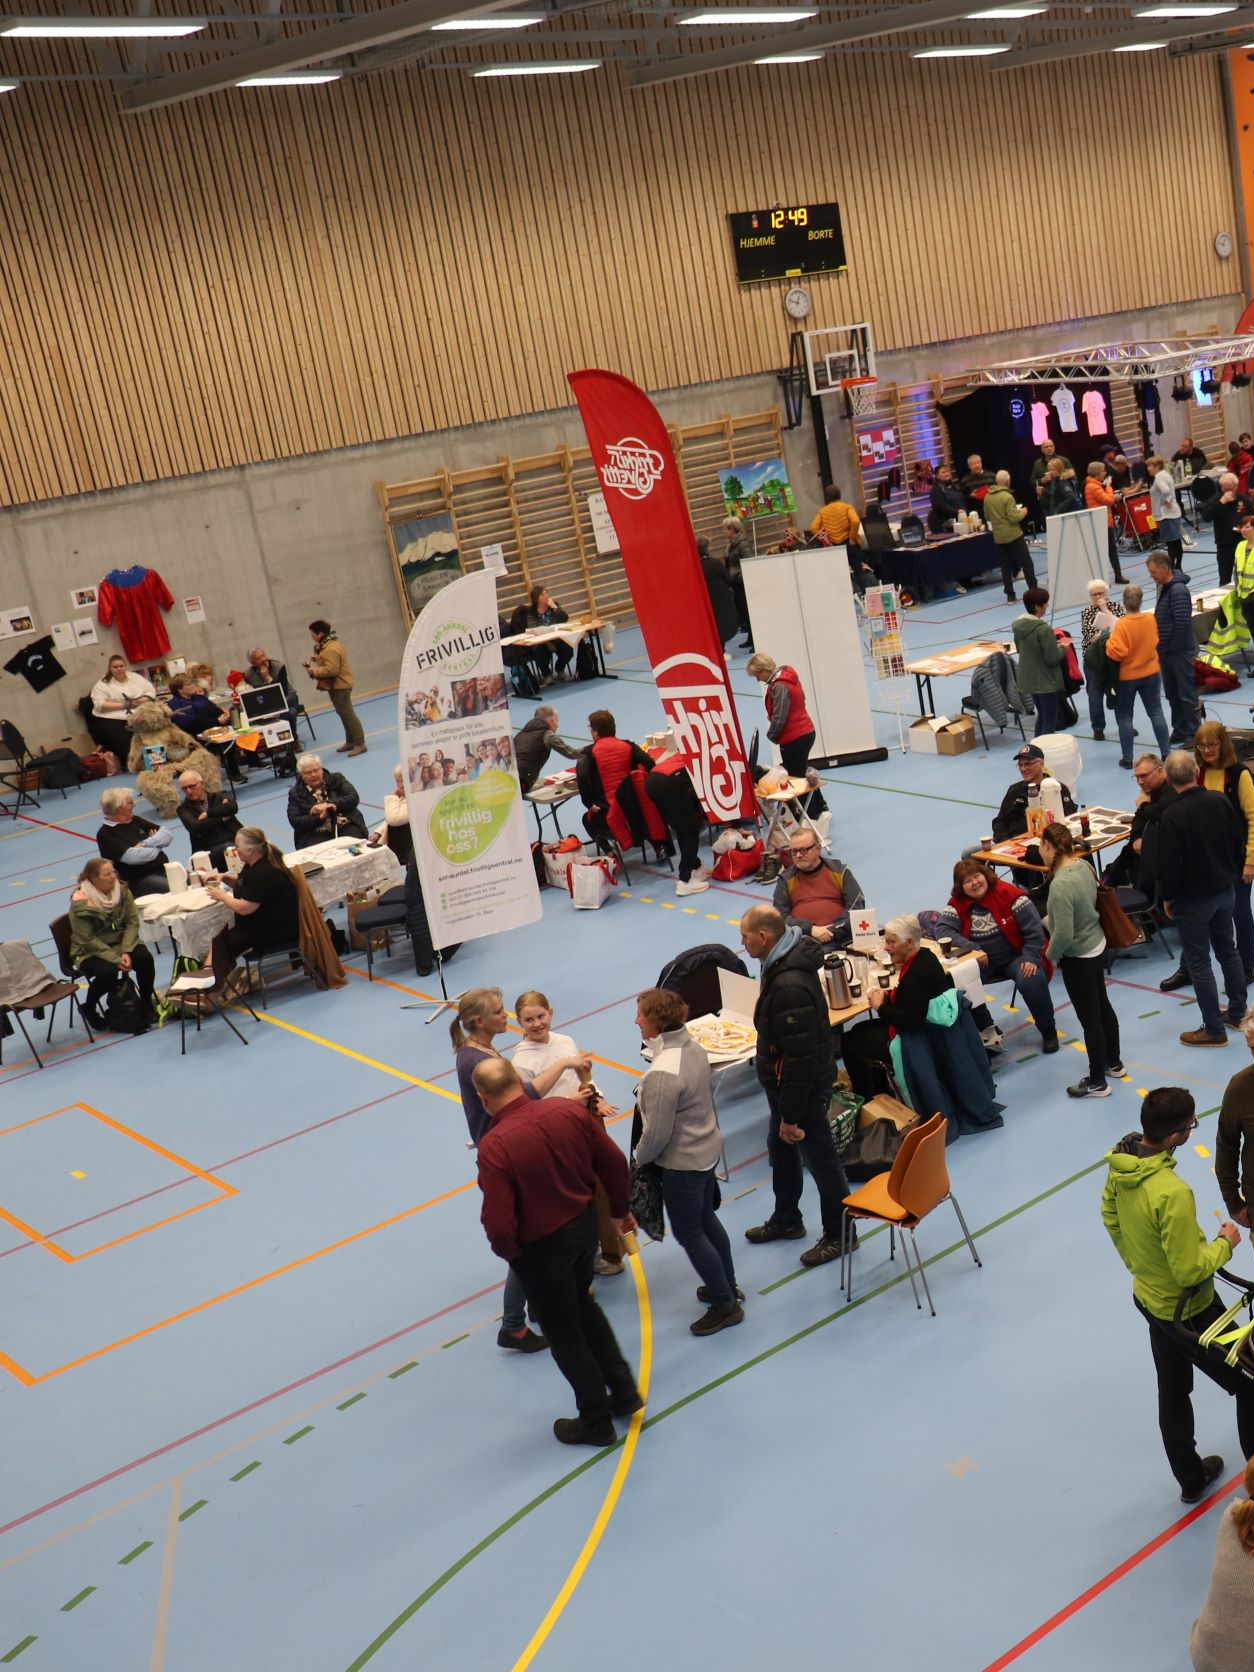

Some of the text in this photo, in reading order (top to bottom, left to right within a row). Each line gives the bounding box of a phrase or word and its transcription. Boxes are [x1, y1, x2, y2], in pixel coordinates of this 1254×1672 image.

[771, 208, 808, 229] 12:49
[740, 228, 834, 248] HJEMME BORTE
[416, 626, 495, 670] FRIVILLIG
[440, 809, 493, 832] frivillig
[448, 826, 476, 841] hos
[446, 836, 479, 854] oss?
